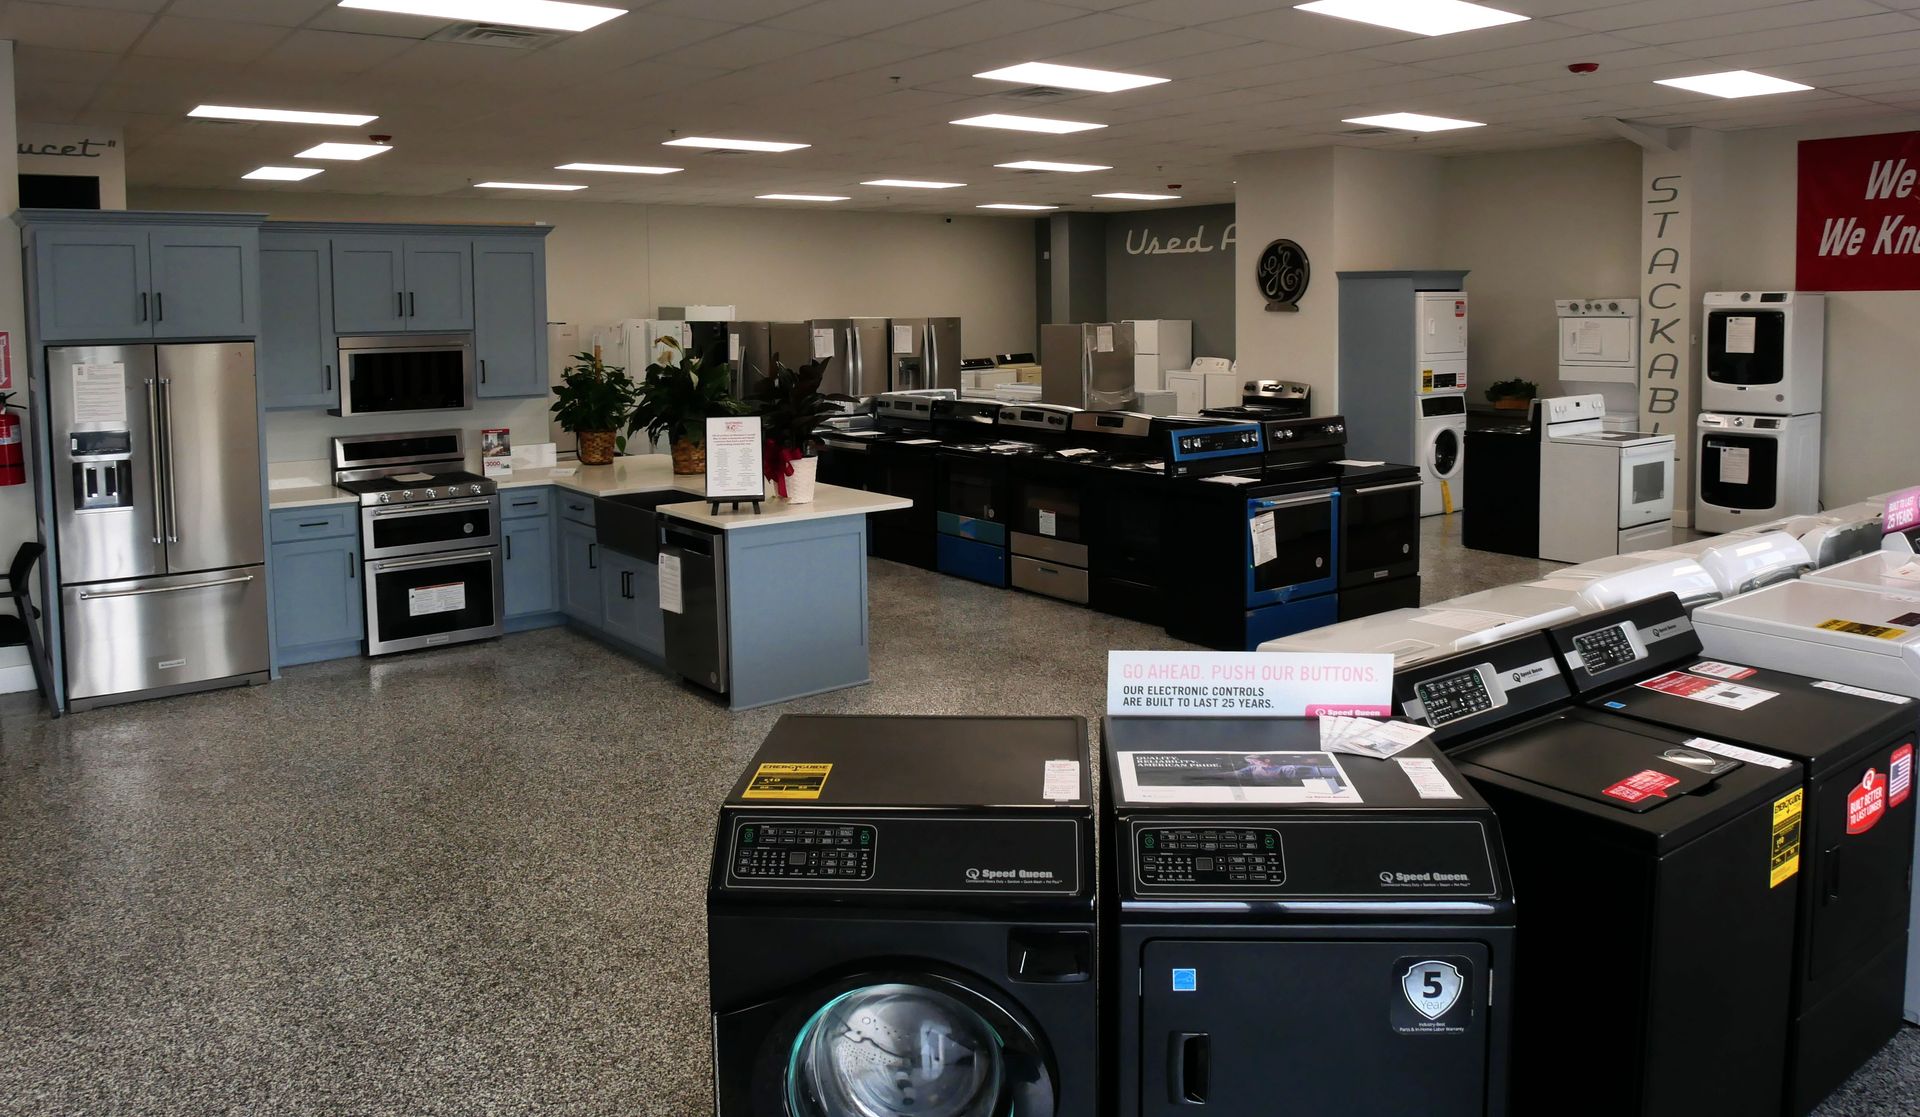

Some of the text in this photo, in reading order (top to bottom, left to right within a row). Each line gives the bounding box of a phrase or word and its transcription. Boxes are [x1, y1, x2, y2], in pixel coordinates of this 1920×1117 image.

[1865, 159, 1917, 200] We
[1126, 225, 1214, 255] Used
[1818, 217, 1866, 256] We
[1123, 664, 1378, 682] GO AHEAD. PUSH OUR BUTTONS.
[1123, 686, 1264, 696] OUR ELECTRONIC CONTROLS
[1123, 697, 1274, 709] ARE BUILT TO LAST 25 YEARS.
[1355, 709, 1380, 717] Queen
[1850, 786, 1883, 814] BUILT BETTER
[1850, 813, 1856, 825] TO
[1857, 807, 1867, 822] LAST
[982, 869, 1016, 879] Speed
[1019, 870, 1053, 878] Queen
[1396, 872, 1430, 882] Speed
[1433, 872, 1468, 881] Queen
[1423, 972, 1442, 998] 5
[1421, 1000, 1444, 1009] Year
